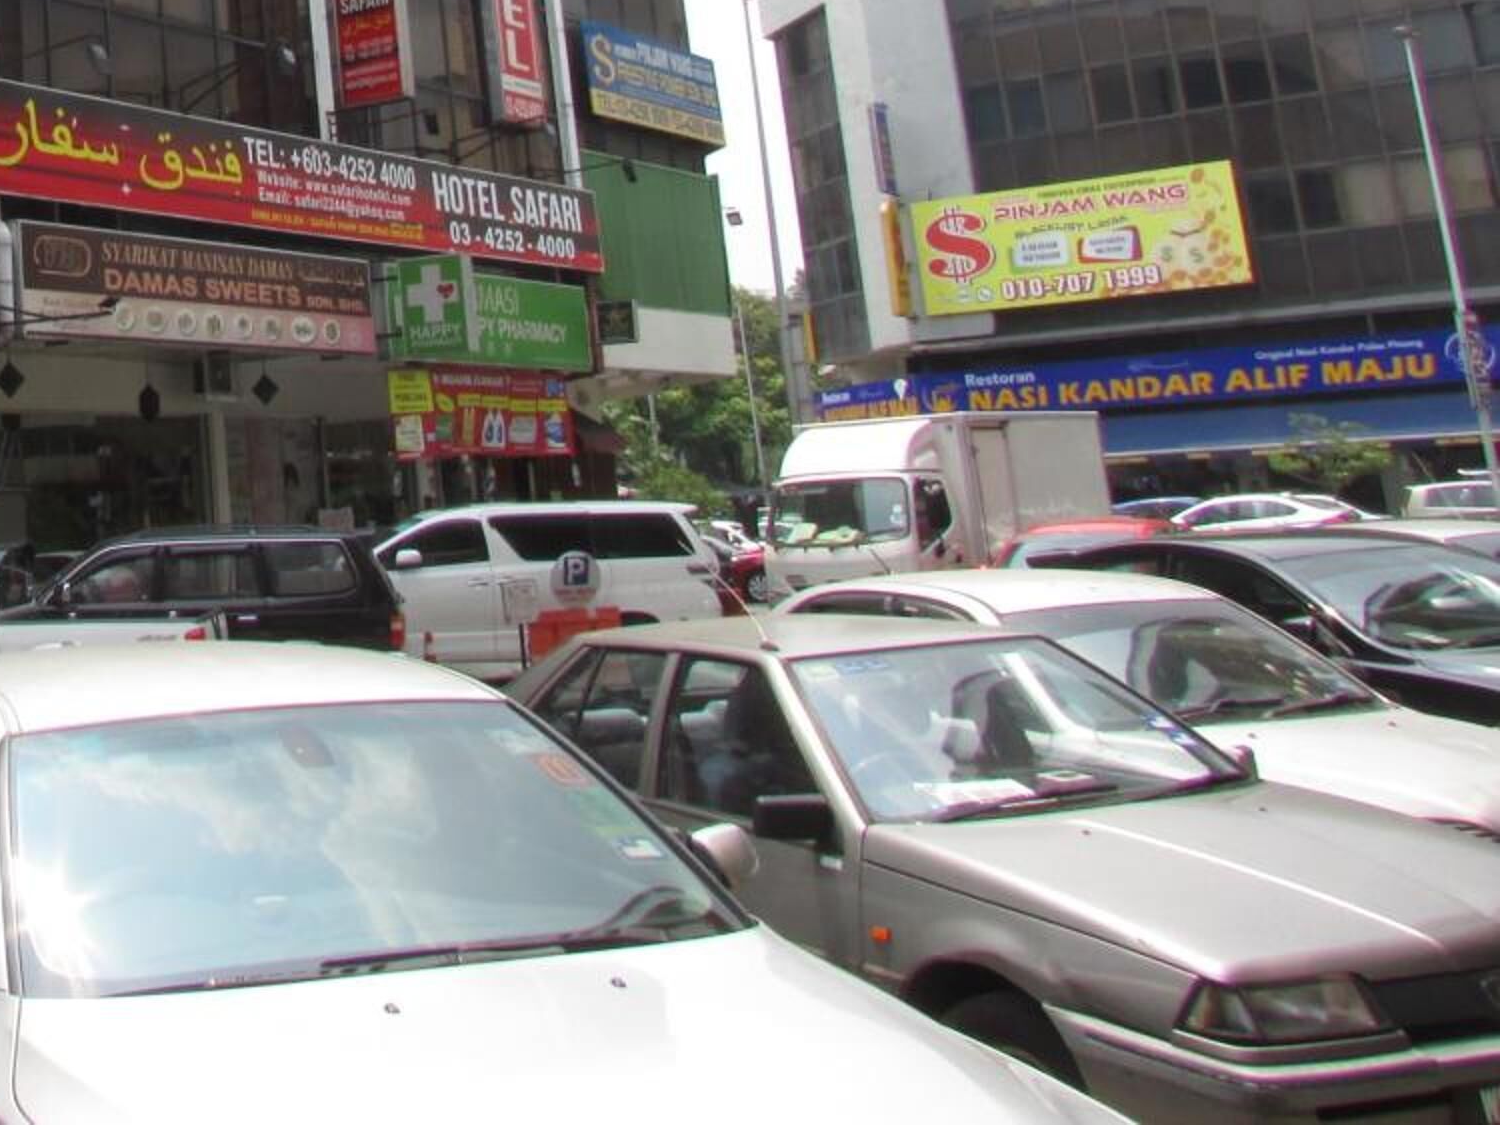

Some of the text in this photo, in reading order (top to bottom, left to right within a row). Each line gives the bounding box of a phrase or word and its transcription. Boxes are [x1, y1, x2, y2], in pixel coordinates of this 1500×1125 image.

[139, 131, 244, 191] فندق
[244, 136, 416, 190] TEL: +603-4252 4000
[258, 186, 290, 205] Email:
[432, 171, 583, 233] HOTEL SAFARI
[994, 197, 1095, 221] PINJAM
[1105, 184, 1187, 208] WANG
[101, 240, 177, 268] SYARIKAT
[450, 220, 472, 246] 03
[484, 227, 525, 253] 4252
[537, 233, 576, 259] 4000
[103, 269, 199, 298] DAMAS
[205, 278, 301, 307] SWEETS
[1001, 263, 1163, 300] 010-707 1999
[500, 319, 566, 344] PHARMACY
[964, 369, 1036, 387] Restoran
[968, 384, 1049, 411] NASI
[1058, 371, 1213, 405] KANDAR
[1224, 363, 1310, 393] ALIF
[1322, 353, 1438, 386] MAJU
